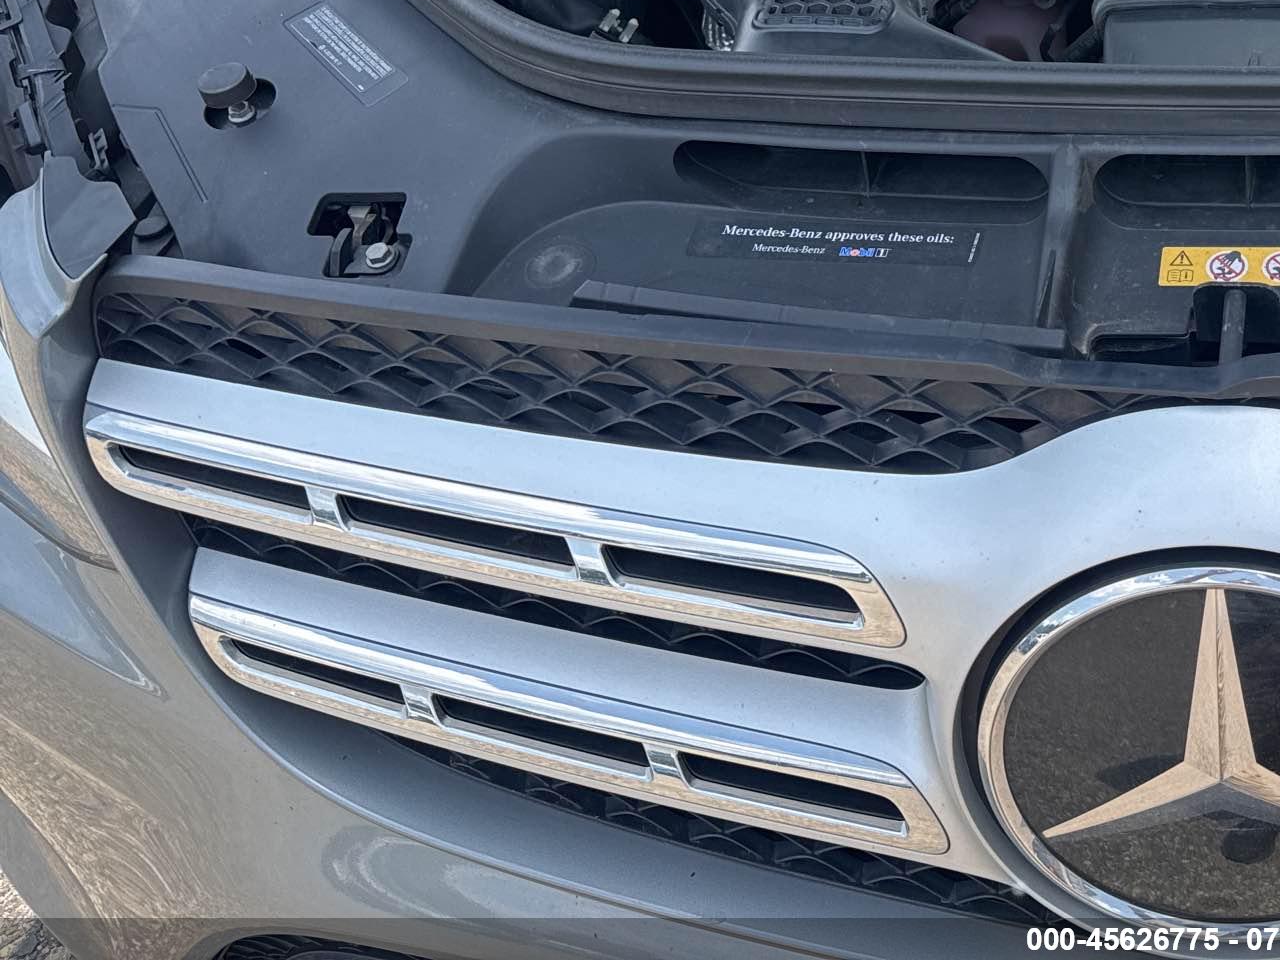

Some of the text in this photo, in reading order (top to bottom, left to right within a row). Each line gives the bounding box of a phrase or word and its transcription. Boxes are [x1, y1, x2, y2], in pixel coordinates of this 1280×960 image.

[721, 224, 955, 244] Mercedes-Benz approves these oils:
[752, 243, 826, 254] Mercedes-Benz
[839, 246, 875, 257] Mobil
